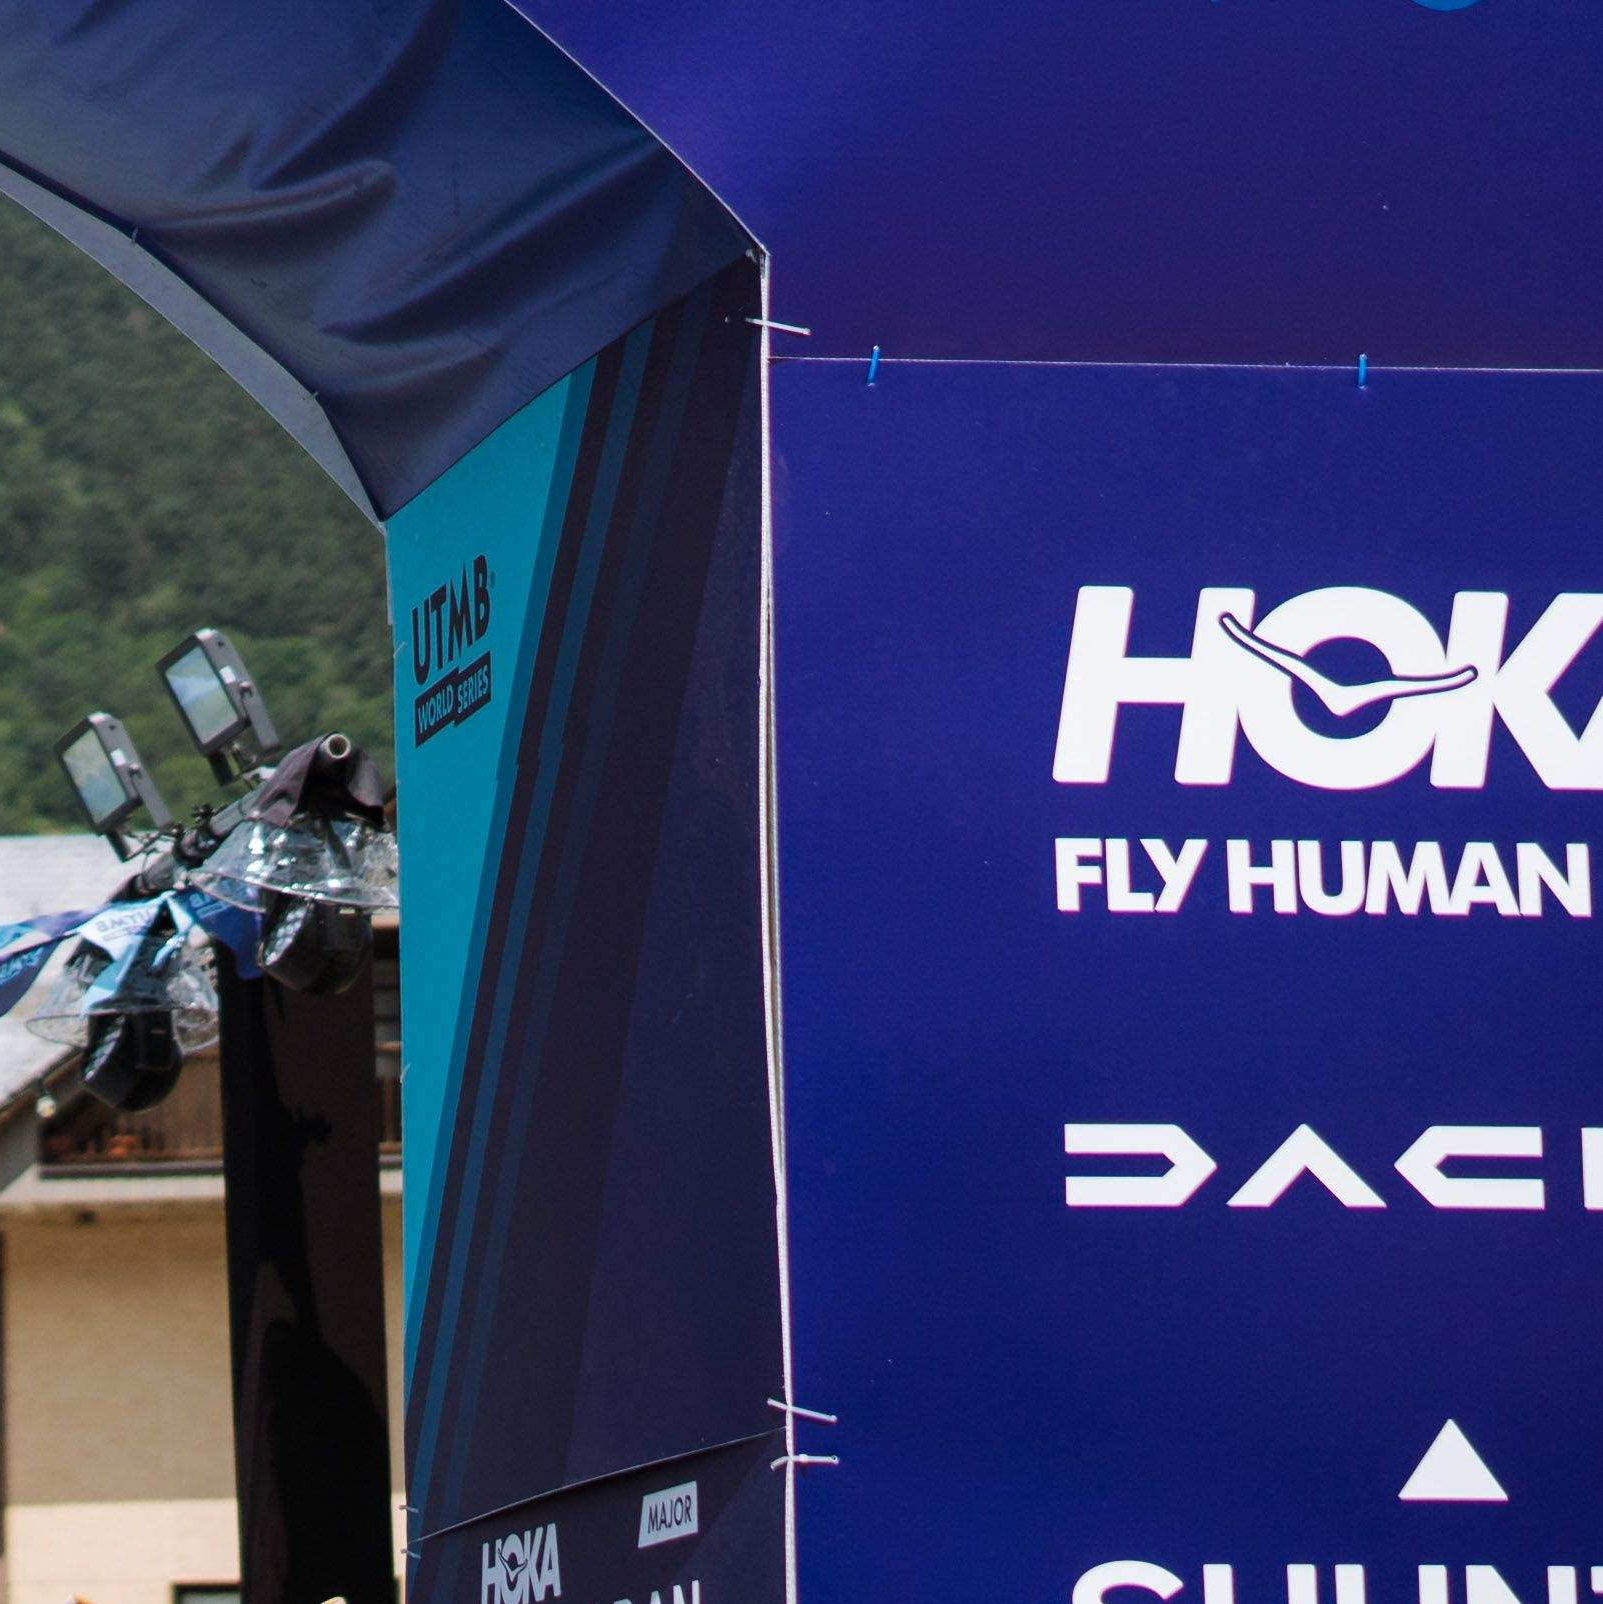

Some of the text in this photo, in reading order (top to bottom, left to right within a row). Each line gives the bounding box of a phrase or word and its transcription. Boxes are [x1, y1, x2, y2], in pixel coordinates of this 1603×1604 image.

[412, 555, 491, 685] UTMB
[418, 665, 489, 734] WORLD SERIES
[1052, 585, 1603, 790] HOK
[1054, 838, 1592, 917] FLY HUMAN
[647, 1496, 692, 1535] MAJOR
